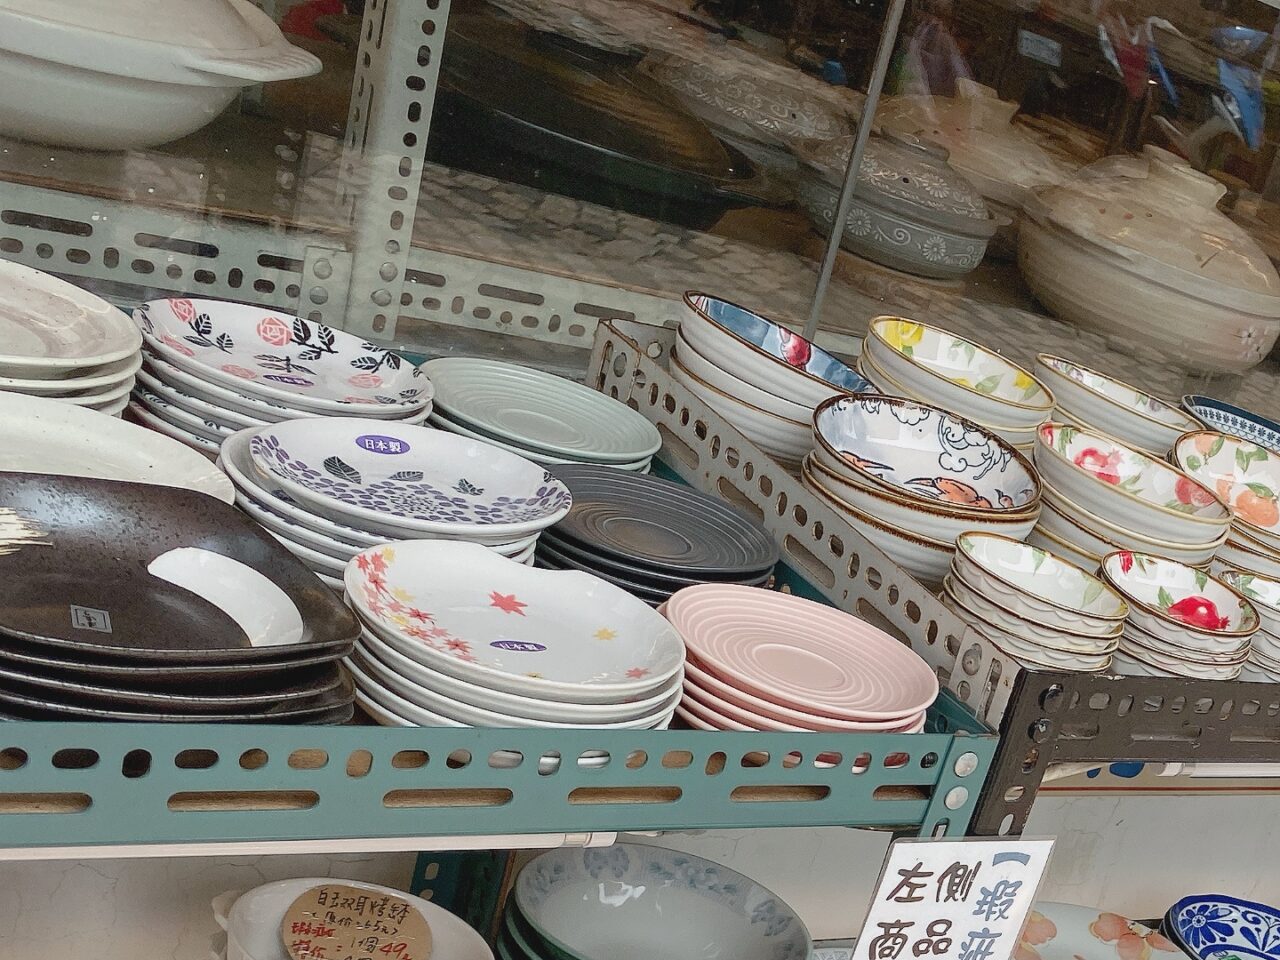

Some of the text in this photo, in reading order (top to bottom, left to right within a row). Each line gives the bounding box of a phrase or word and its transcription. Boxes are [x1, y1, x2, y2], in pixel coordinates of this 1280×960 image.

[364, 438, 401, 453] 日本製
[886, 861, 982, 903] 左側
